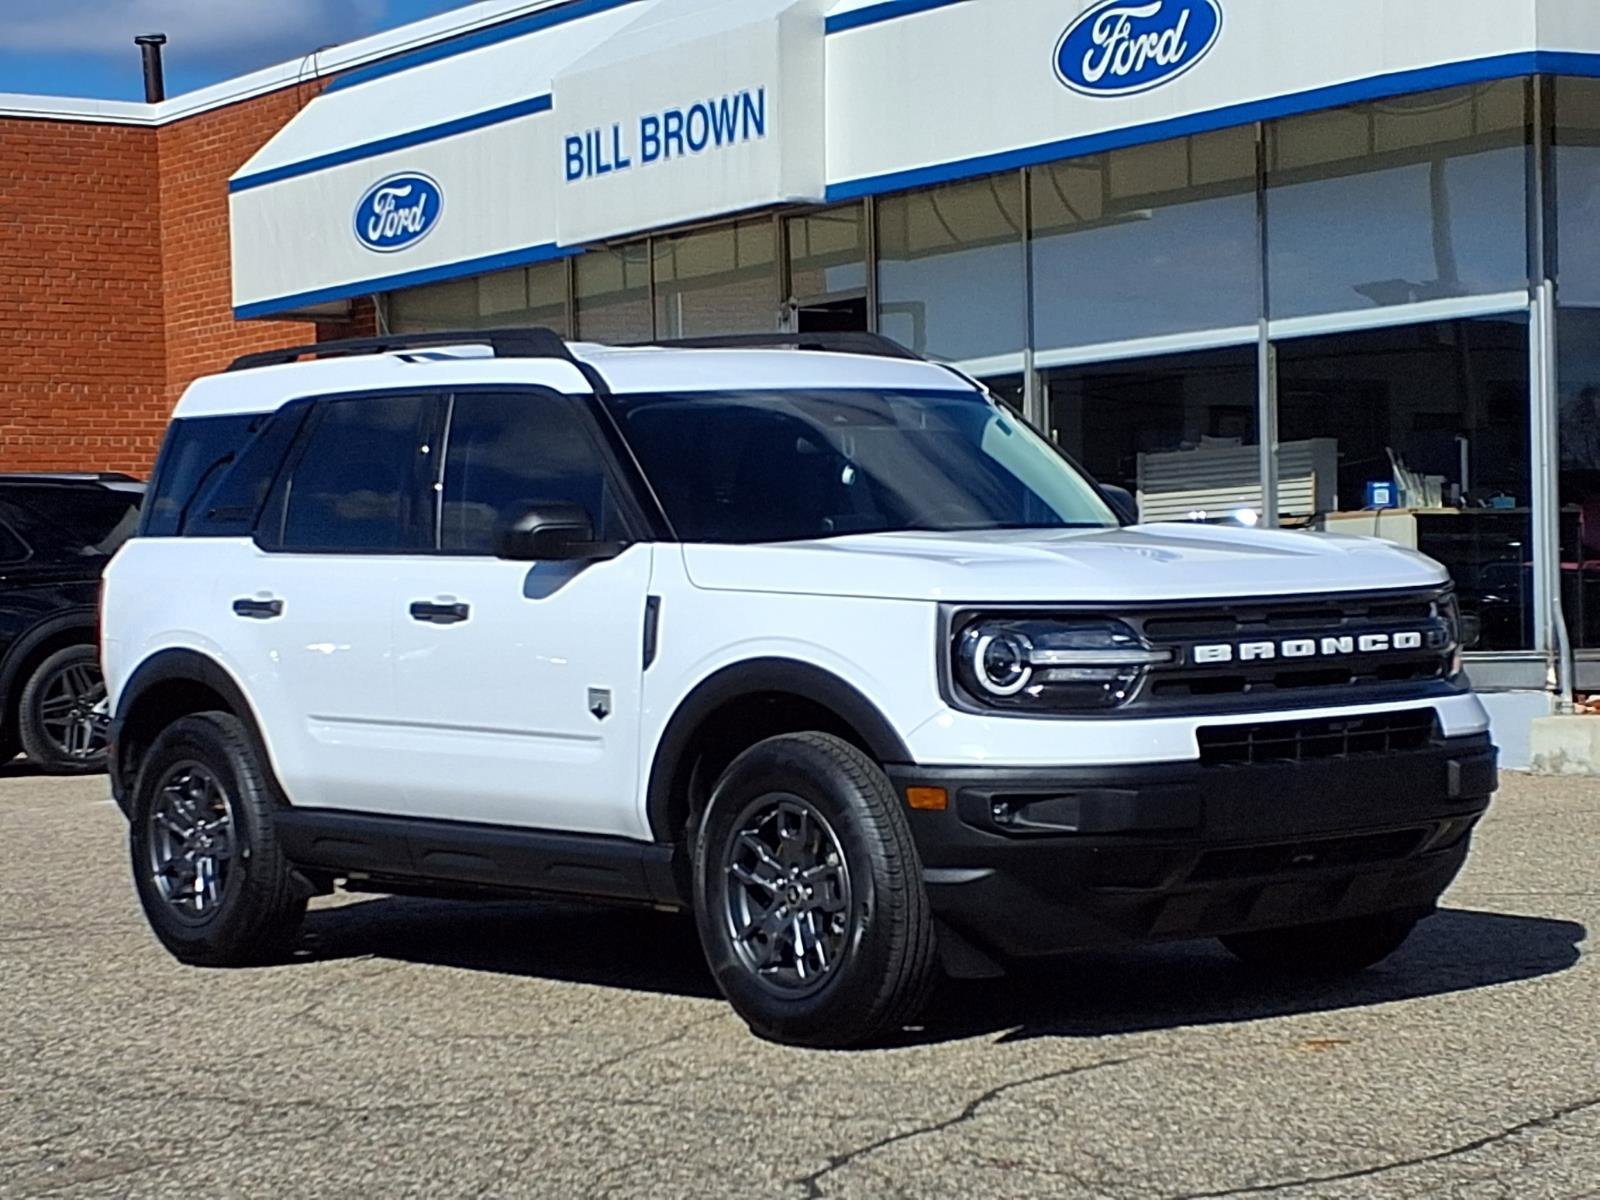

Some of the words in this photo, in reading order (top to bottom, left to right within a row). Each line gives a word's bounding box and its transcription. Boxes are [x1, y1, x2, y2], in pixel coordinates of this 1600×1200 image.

[1082, 0, 1190, 82] Ford
[565, 123, 631, 182] BILL
[640, 86, 765, 164] BROWN
[367, 184, 427, 241] Ford
[1194, 631, 1422, 663] BRONCO
